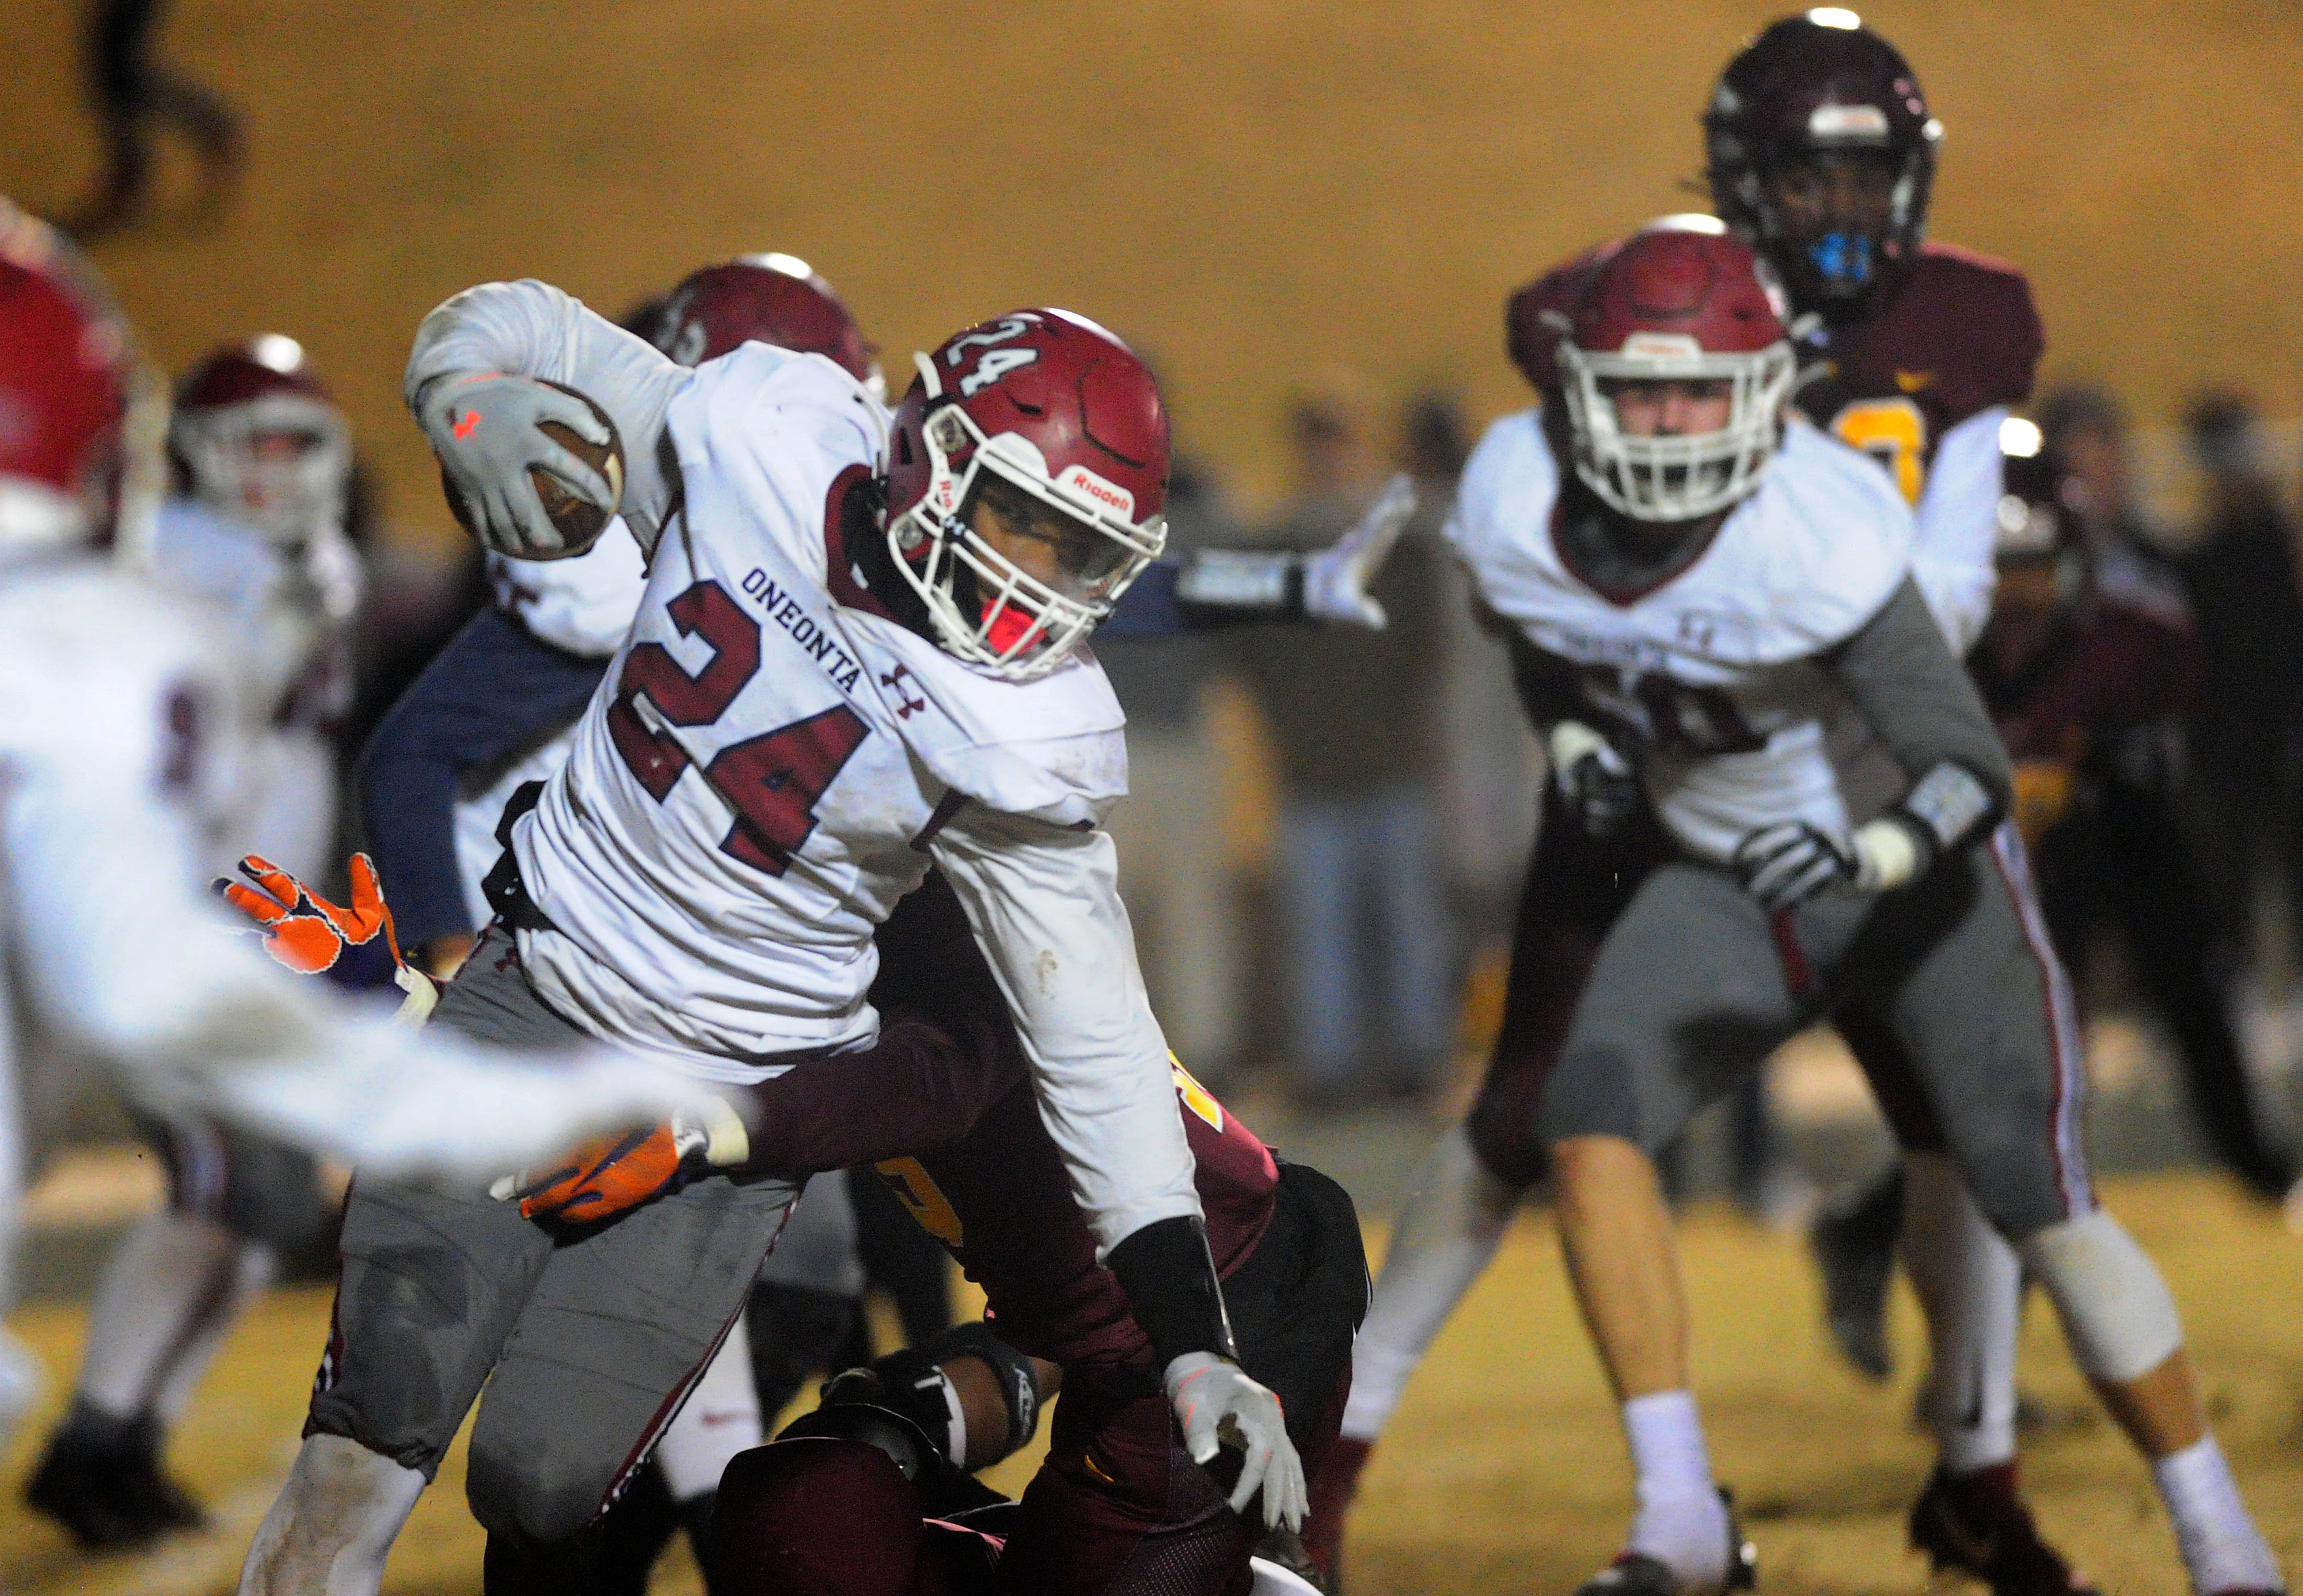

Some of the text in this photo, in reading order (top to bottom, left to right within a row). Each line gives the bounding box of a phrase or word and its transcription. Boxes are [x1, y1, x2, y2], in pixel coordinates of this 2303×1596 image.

[946, 321, 1039, 398] 24
[1074, 473, 1130, 511] Riddell
[742, 567, 863, 693] ONEONTA
[607, 579, 872, 877] 24
